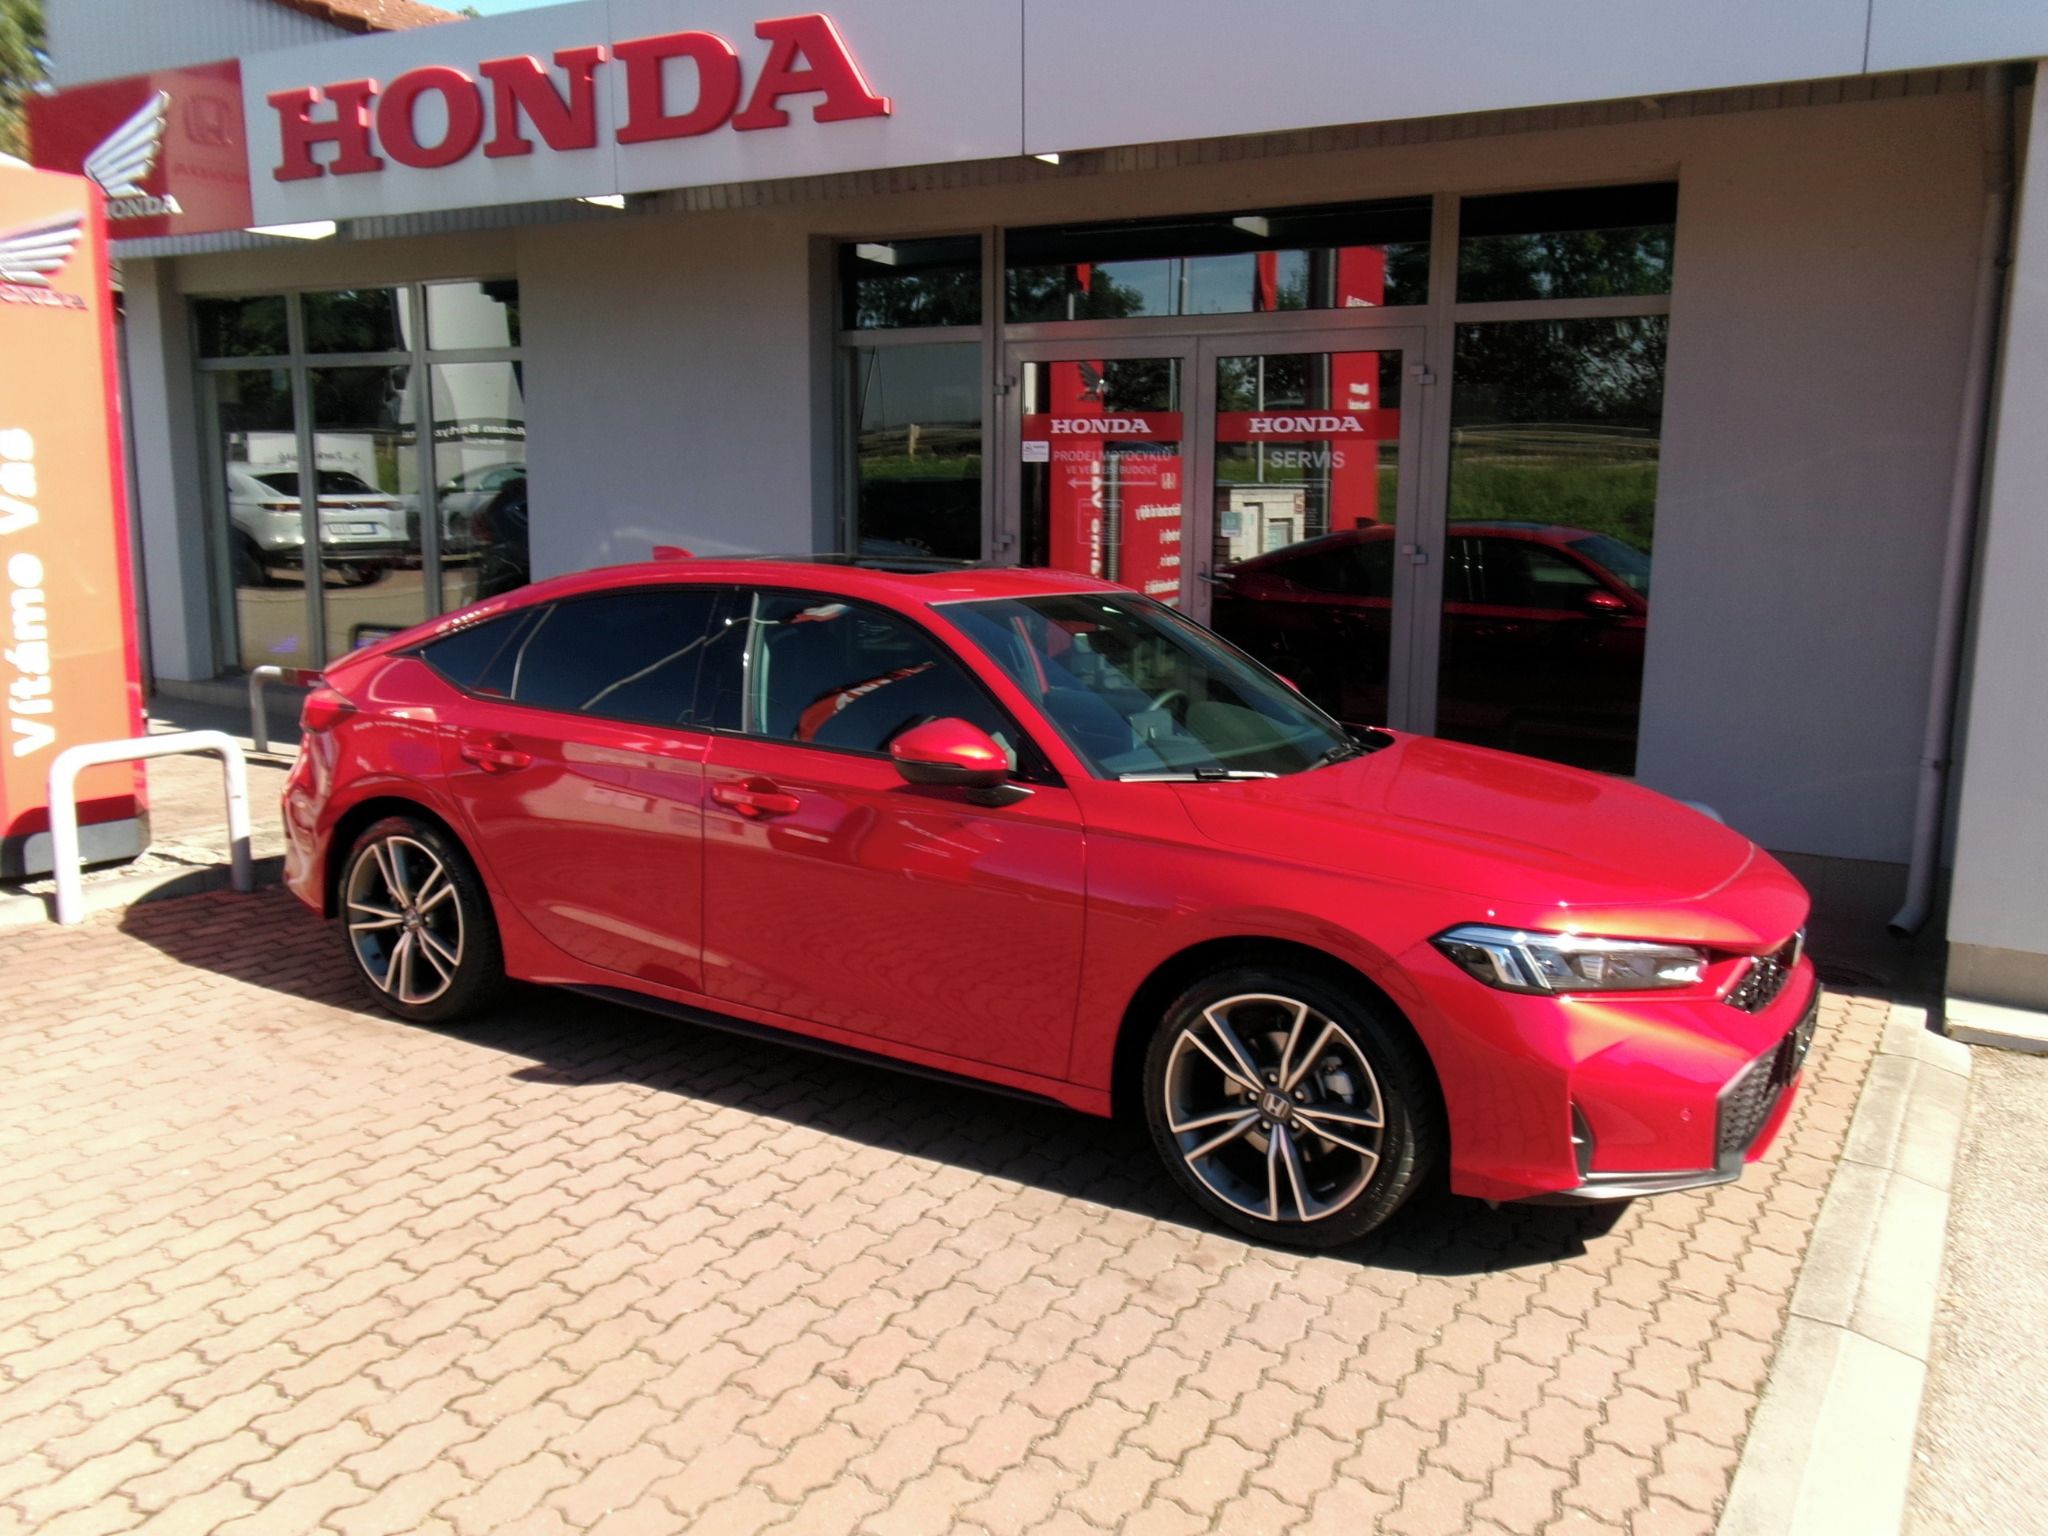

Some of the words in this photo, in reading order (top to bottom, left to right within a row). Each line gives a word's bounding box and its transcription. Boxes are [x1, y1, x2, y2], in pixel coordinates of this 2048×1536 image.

[266, 11, 892, 183] HONDA
[108, 194, 184, 219] ONDA
[1050, 418, 1152, 433] HONDA
[1249, 416, 1364, 433] HONDA
[1270, 451, 1346, 469] SERVIS
